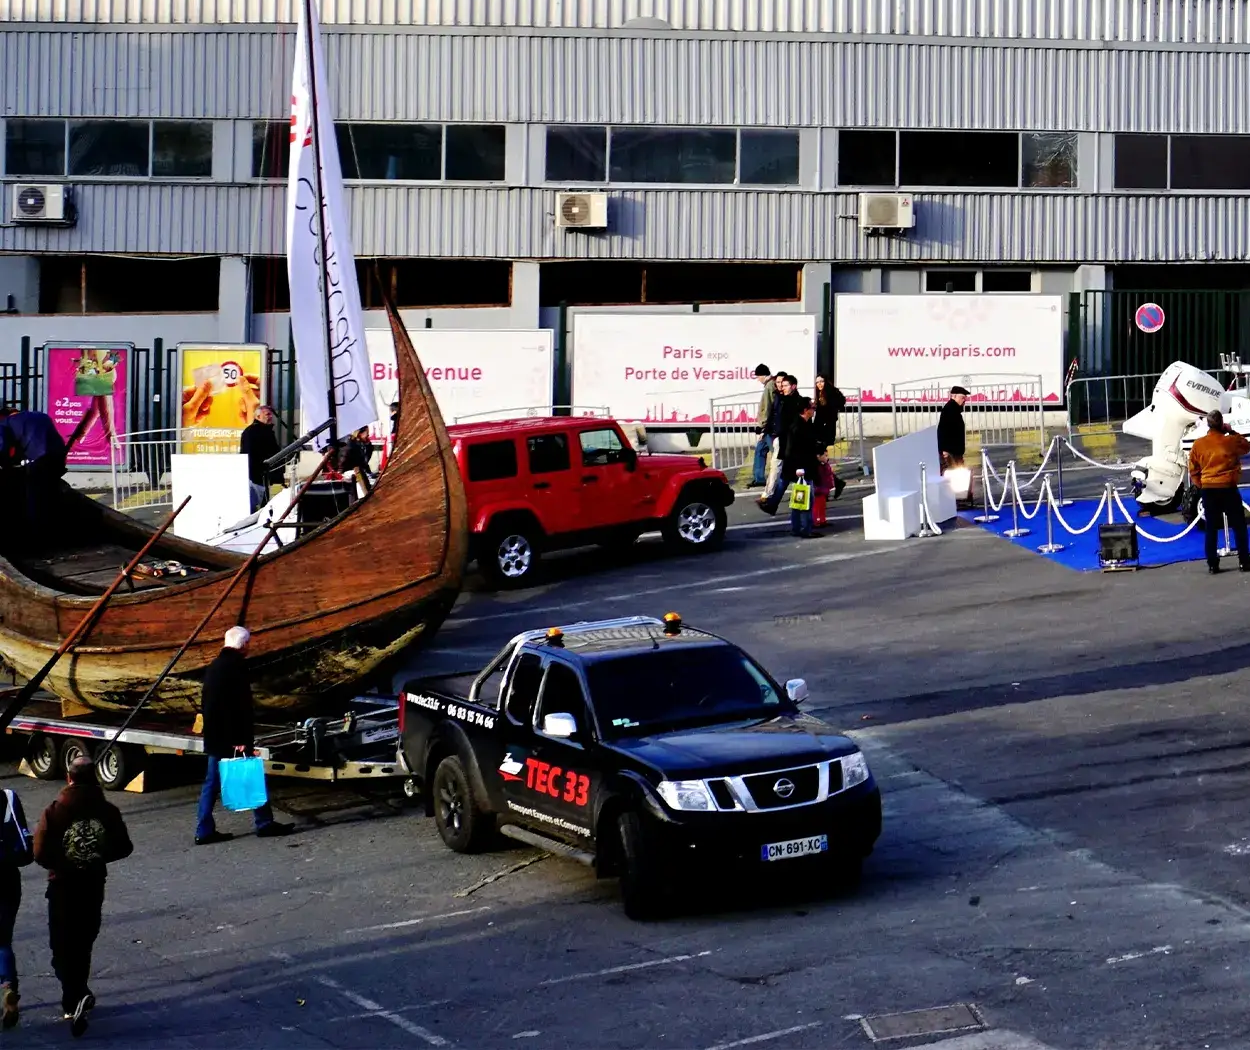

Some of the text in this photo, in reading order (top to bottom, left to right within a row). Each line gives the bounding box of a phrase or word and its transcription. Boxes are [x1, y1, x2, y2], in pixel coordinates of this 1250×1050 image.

[663, 345, 729, 361] Paris expo
[888, 344, 1016, 359] www.viparis.com
[223, 368, 238, 380] 50
[373, 363, 482, 380] Bivenue
[625, 366, 758, 380] Porte de Versaille
[1186, 379, 1222, 399] EVINRUDE
[62, 397, 70, 407] 2
[65, 409, 83, 417] chez
[447, 703, 457, 717] 06
[456, 706, 467, 720] 83
[467, 710, 475, 723] 15
[475, 712, 484, 726] 74
[484, 716, 494, 729] 66
[525, 757, 590, 806] TEC 33
[768, 838, 820, 857] CN-691-XC
